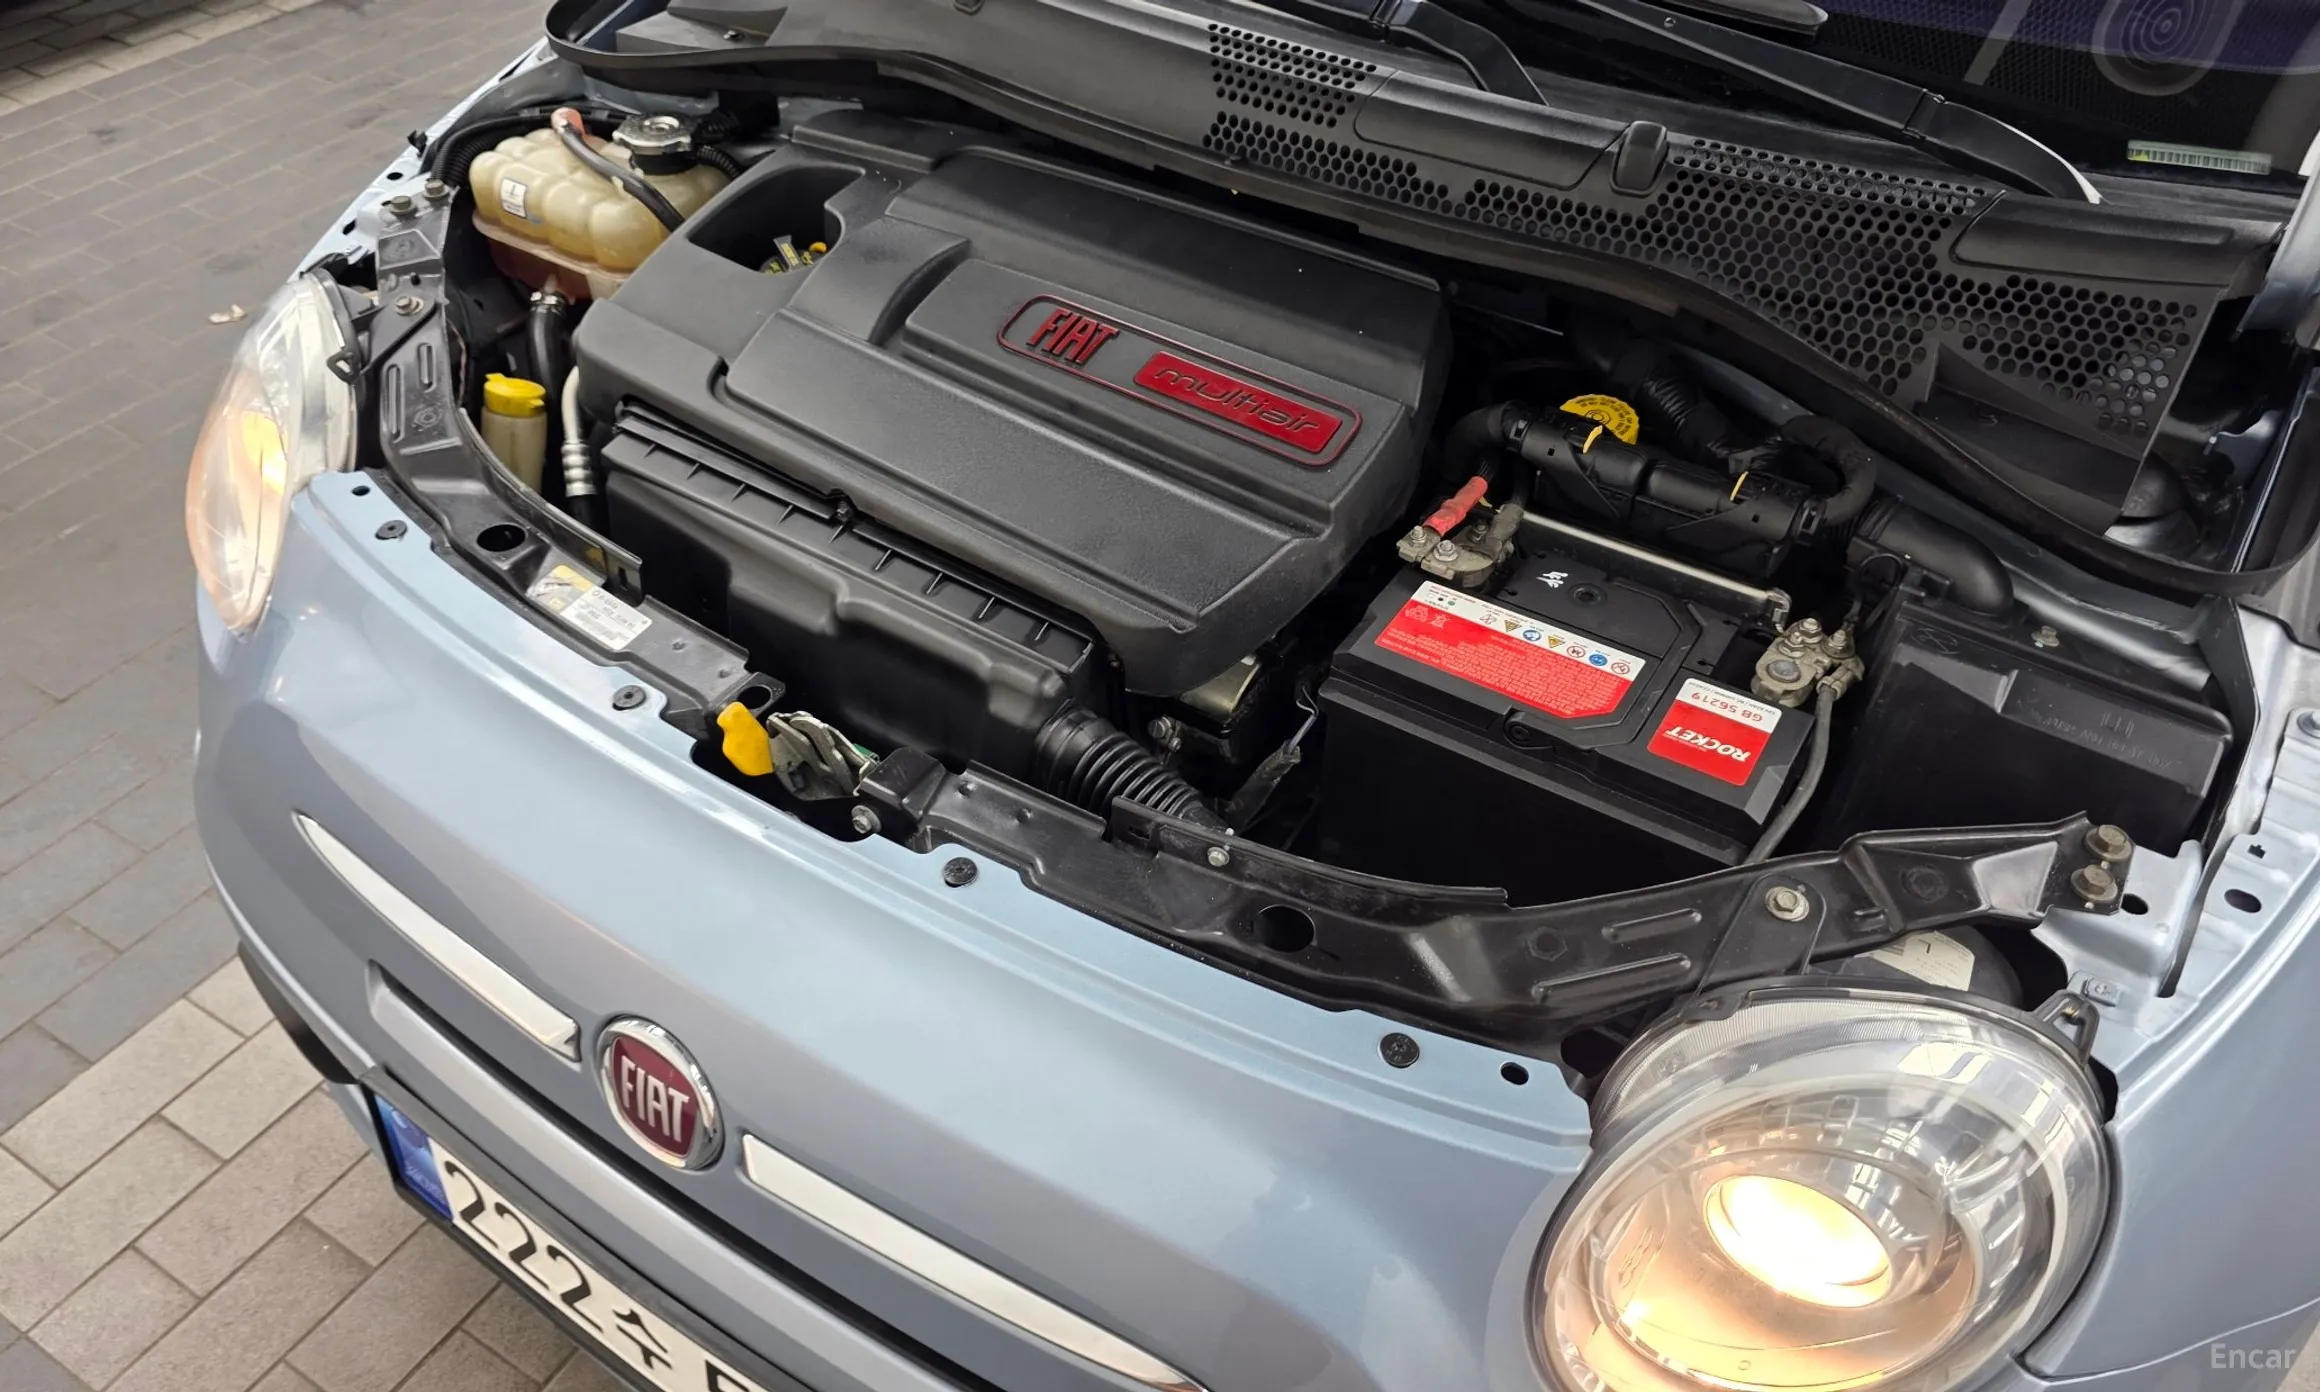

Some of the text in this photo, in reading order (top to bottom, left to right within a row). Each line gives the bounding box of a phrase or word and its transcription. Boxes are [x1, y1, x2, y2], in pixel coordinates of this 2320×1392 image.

[1026, 306, 1321, 433] FIAT multiair
[1691, 691, 1738, 714] 56219
[1741, 708, 1764, 723] GB
[1665, 726, 1752, 763] ROCKET
[620, 1055, 690, 1143] FIAT
[443, 1160, 673, 1371] 222수
